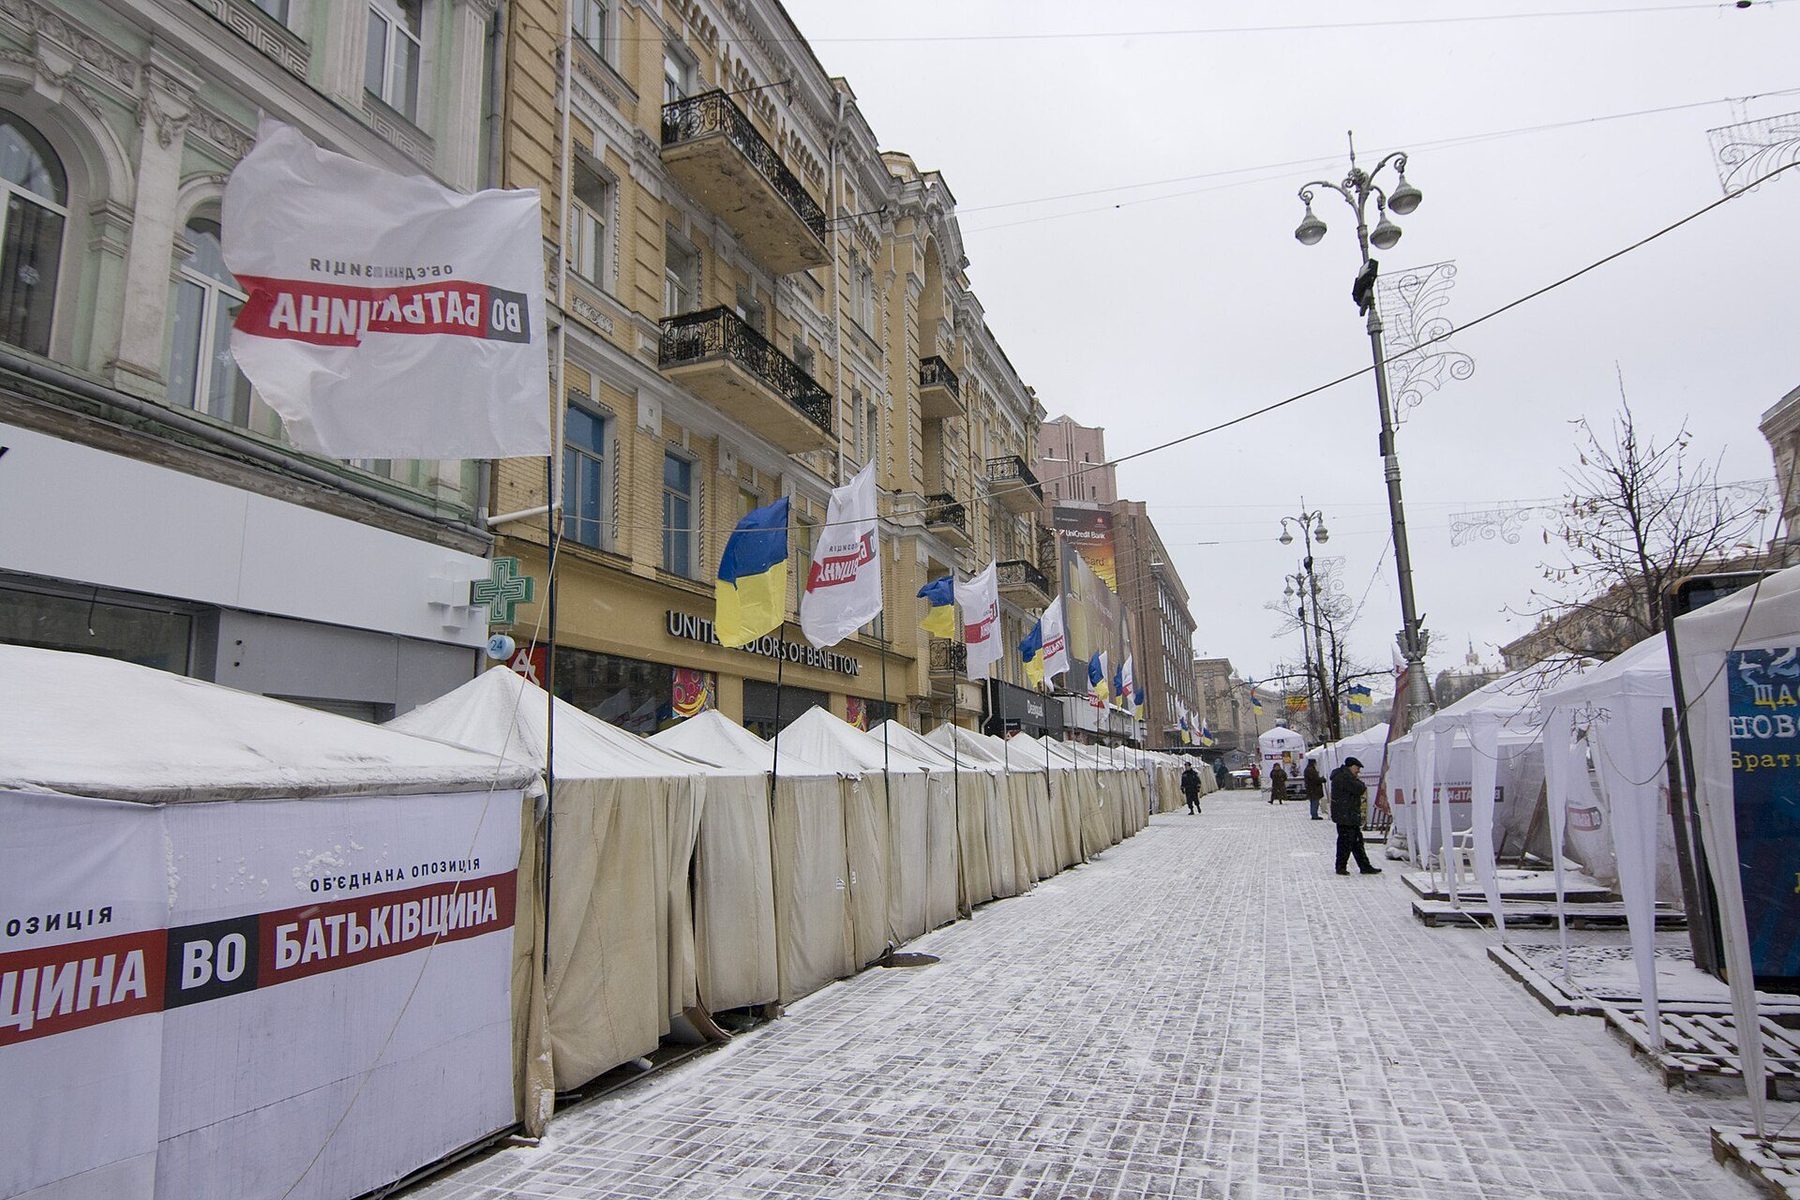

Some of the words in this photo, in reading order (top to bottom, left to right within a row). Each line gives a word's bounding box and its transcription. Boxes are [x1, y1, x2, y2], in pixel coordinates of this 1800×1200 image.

[490, 639, 503, 651] 24
[669, 610, 719, 645] UNITE
[738, 634, 787, 660] OLORS
[789, 642, 805, 662] OF
[806, 648, 861, 675] BENETTON
[1753, 683, 1800, 711] ЩА
[1729, 714, 1800, 739] НОВ
[411, 857, 481, 879] ОПОЗИЦІЯ
[181, 932, 247, 991] ВО
[274, 886, 499, 971] БАТЬКІВЩИНА
